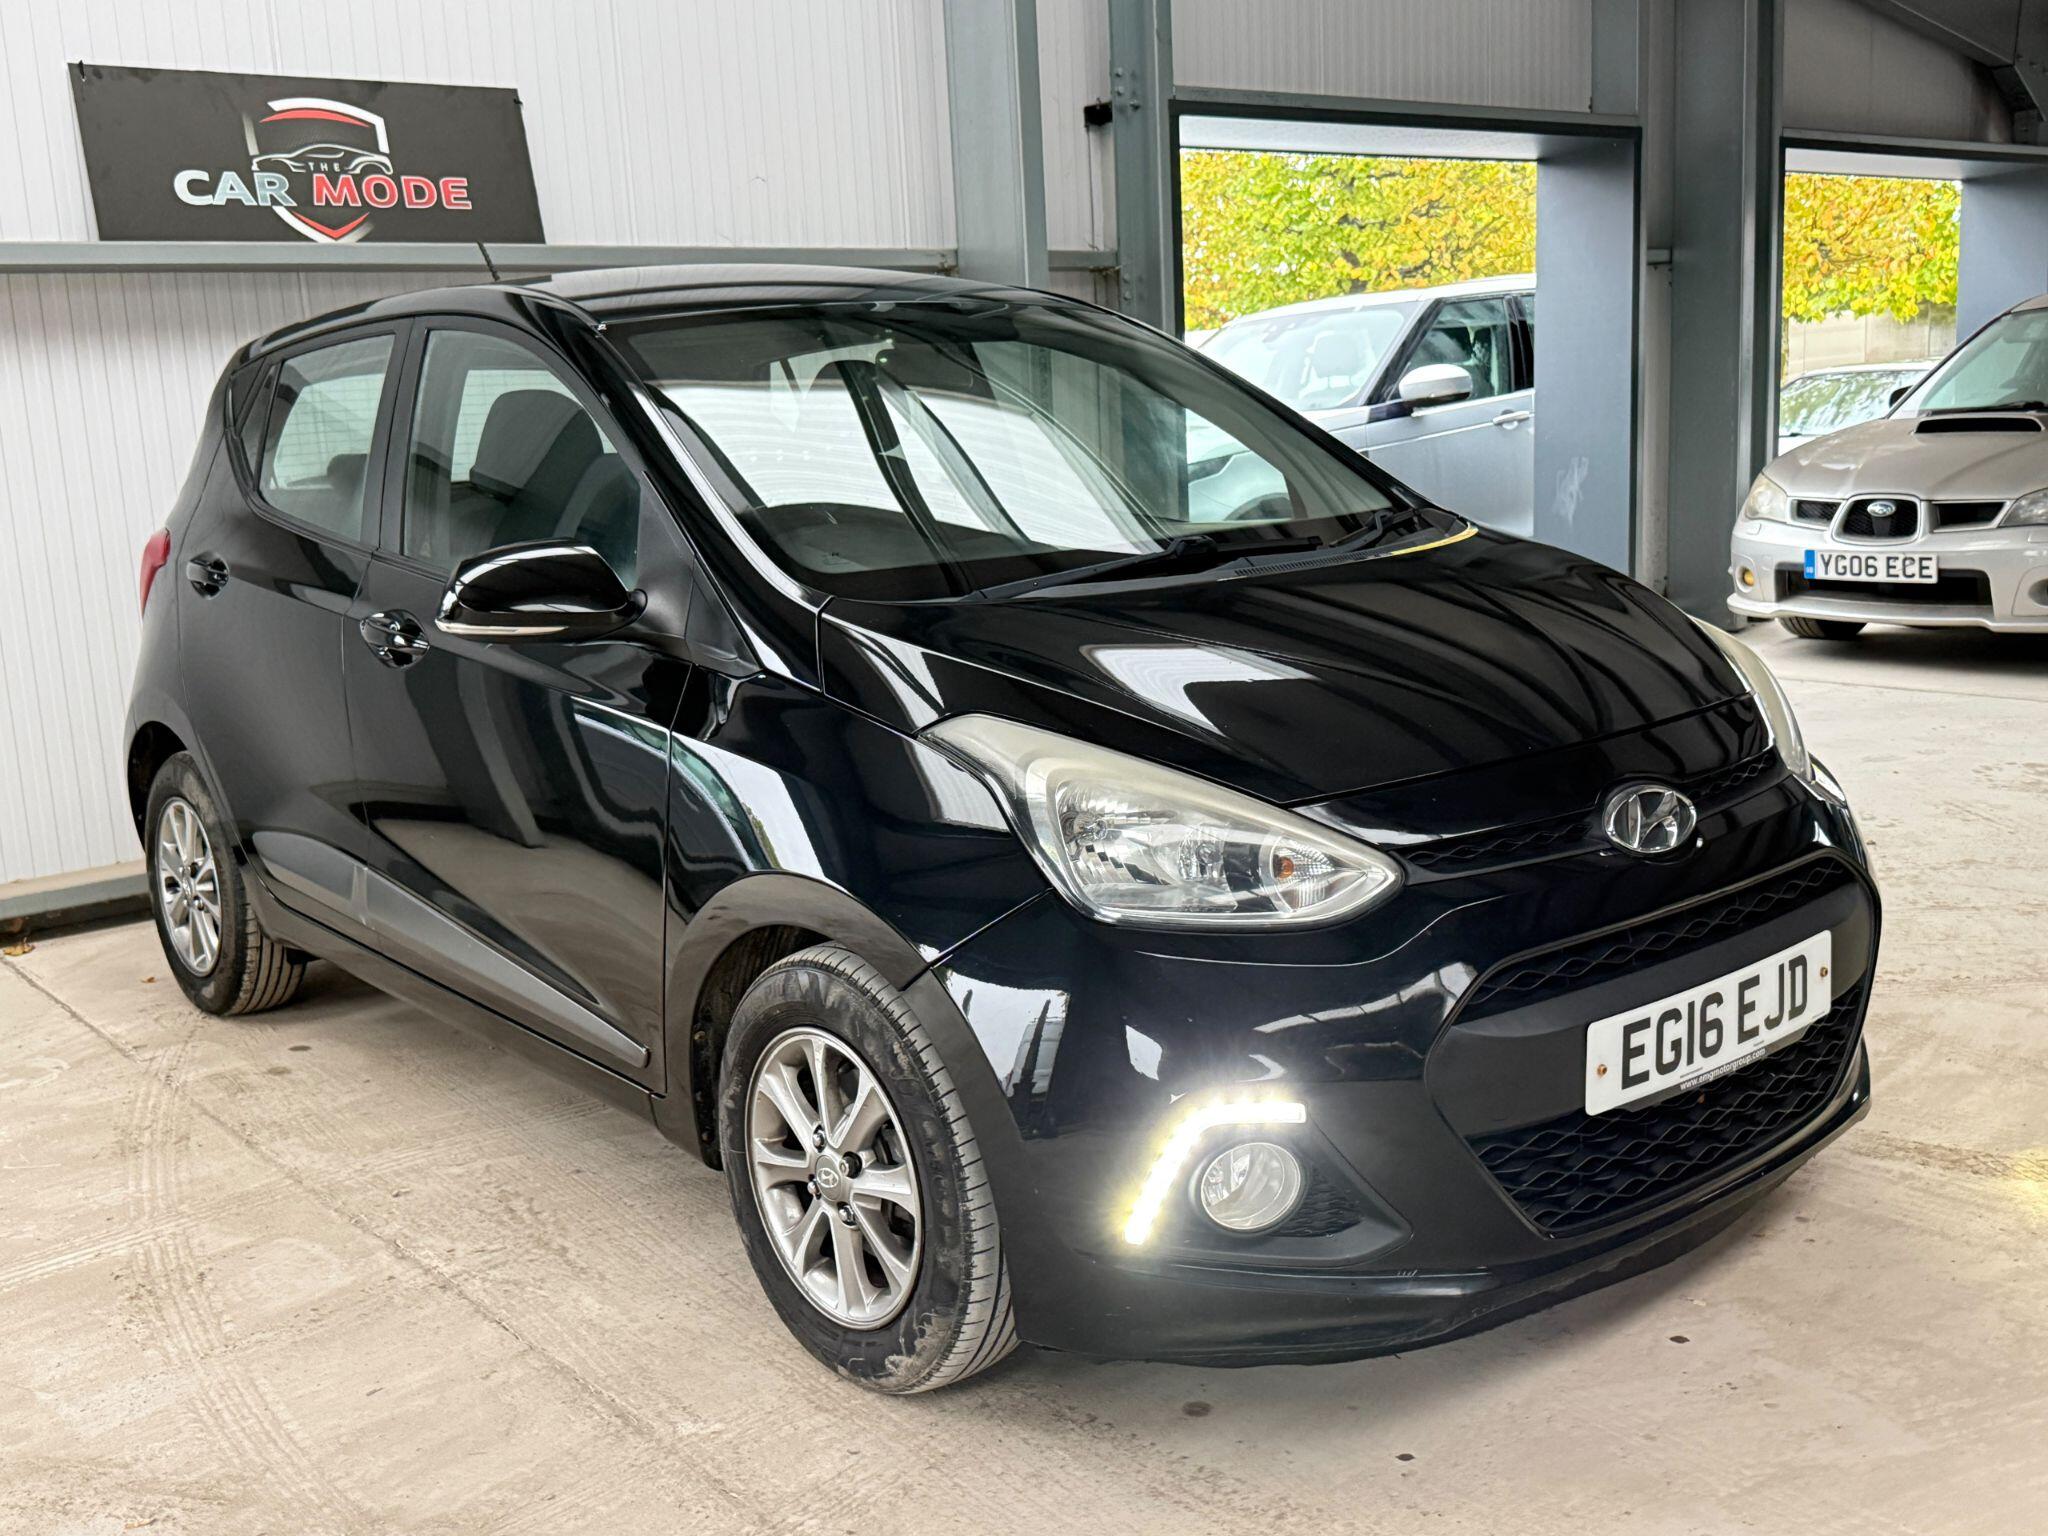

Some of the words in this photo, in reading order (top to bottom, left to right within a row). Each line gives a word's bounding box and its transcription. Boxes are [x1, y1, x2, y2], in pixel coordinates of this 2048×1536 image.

[308, 161, 341, 173] THE
[173, 169, 298, 207] CAR
[312, 172, 473, 210] MODE
[1820, 554, 1878, 577] YG06
[1886, 556, 1933, 579] ECE
[1621, 991, 1724, 1090] EG16
[1737, 954, 1808, 1045] EJD
